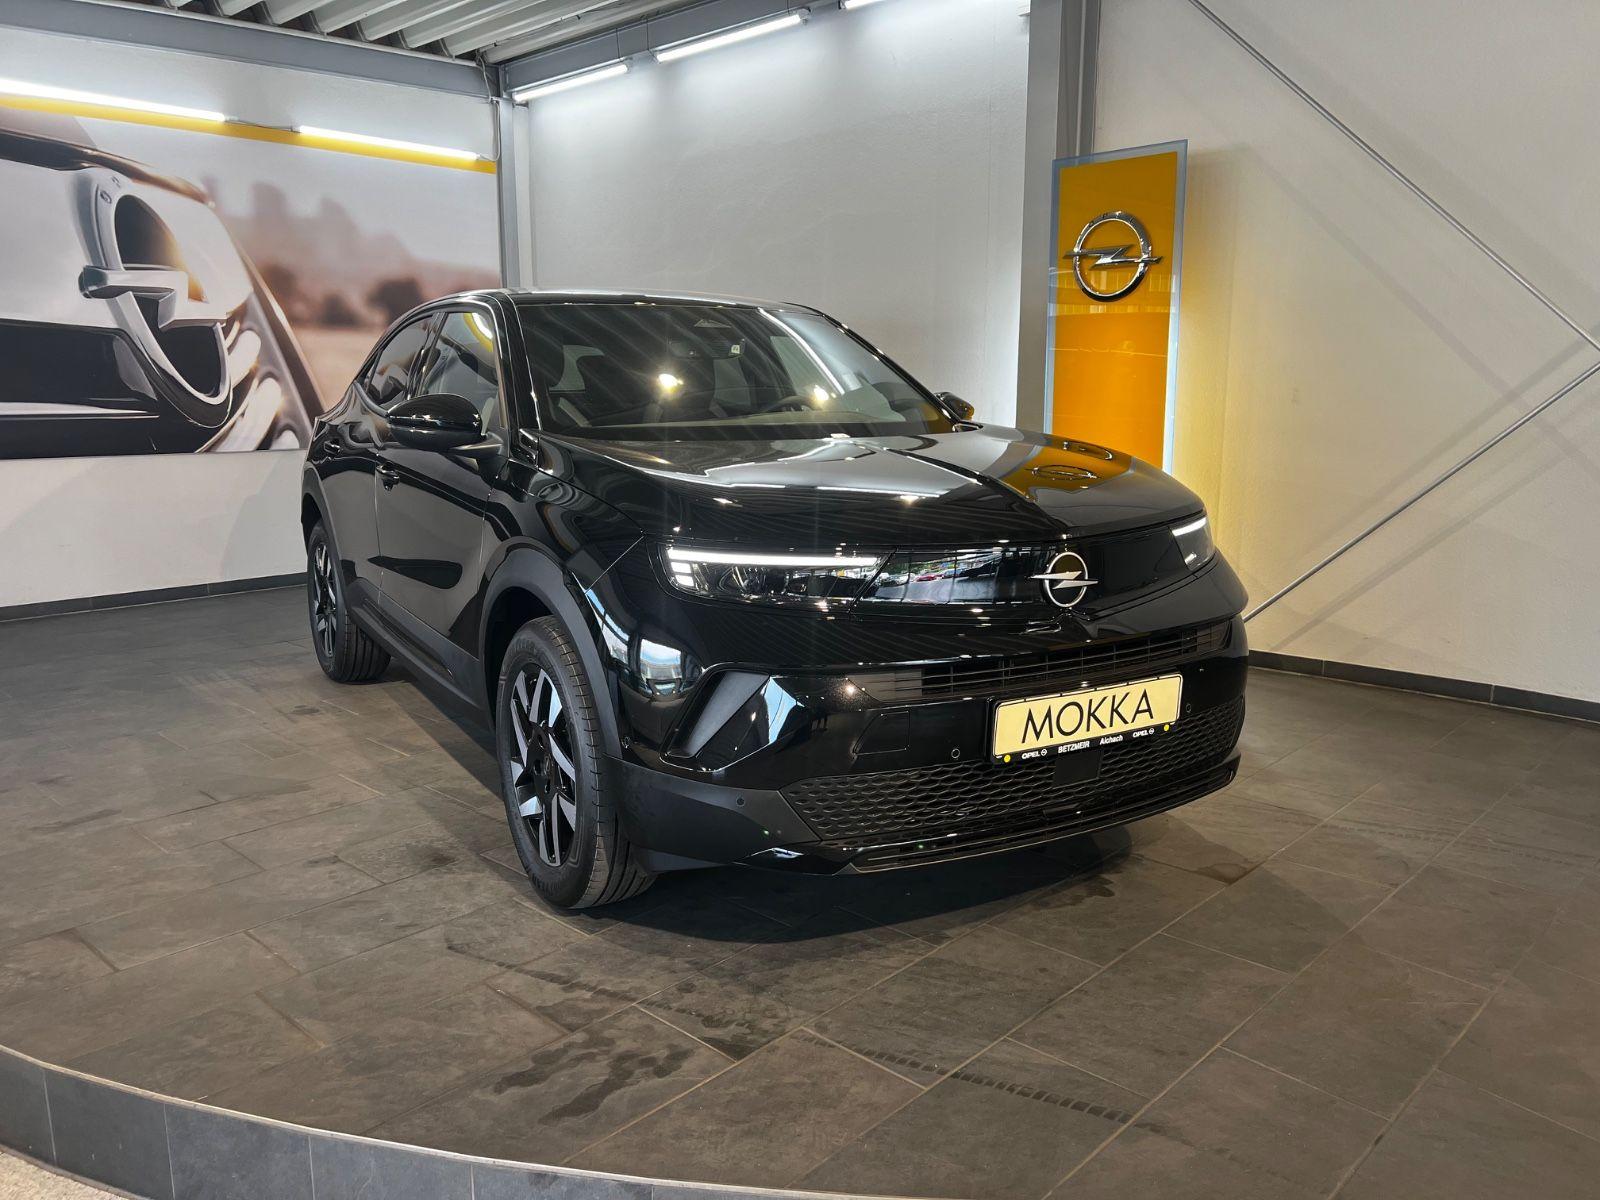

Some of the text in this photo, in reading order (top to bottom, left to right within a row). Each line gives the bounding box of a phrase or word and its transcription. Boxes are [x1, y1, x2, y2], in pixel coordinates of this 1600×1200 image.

[1021, 689, 1154, 744] MOKKA
[1021, 751, 1041, 760] OPEL
[1132, 729, 1149, 738] OPEL
